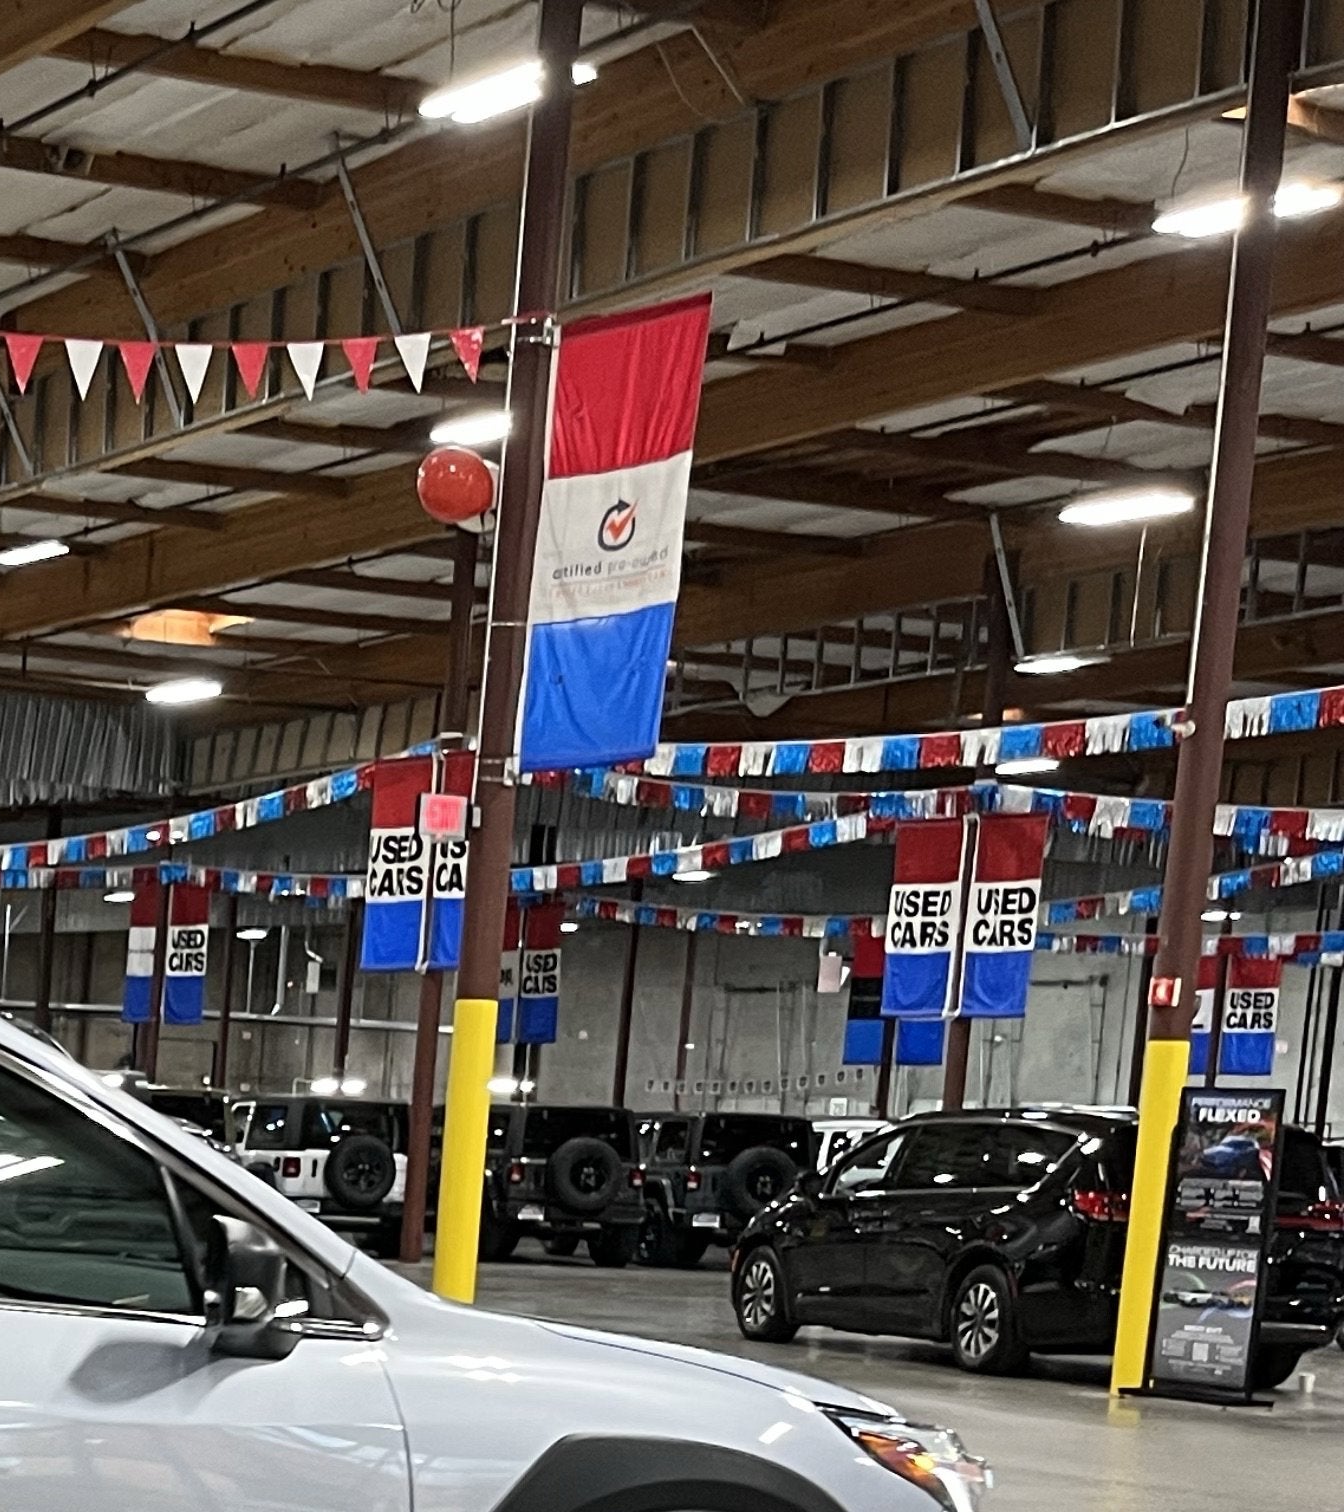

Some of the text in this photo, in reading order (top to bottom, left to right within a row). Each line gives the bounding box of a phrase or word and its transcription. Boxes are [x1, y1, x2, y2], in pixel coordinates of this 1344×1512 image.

[370, 835, 423, 864] USED
[369, 866, 423, 896] CARS
[894, 890, 952, 917] USED
[977, 887, 1036, 916] USED
[172, 929, 205, 949] USED
[891, 921, 950, 948] CARS
[973, 918, 1034, 947] CARS
[1230, 991, 1275, 1010] USED
[1226, 1011, 1273, 1030] CARS
[1199, 1108, 1261, 1123] FLEXED
[1168, 1254, 1256, 1273] THE FUTURE
